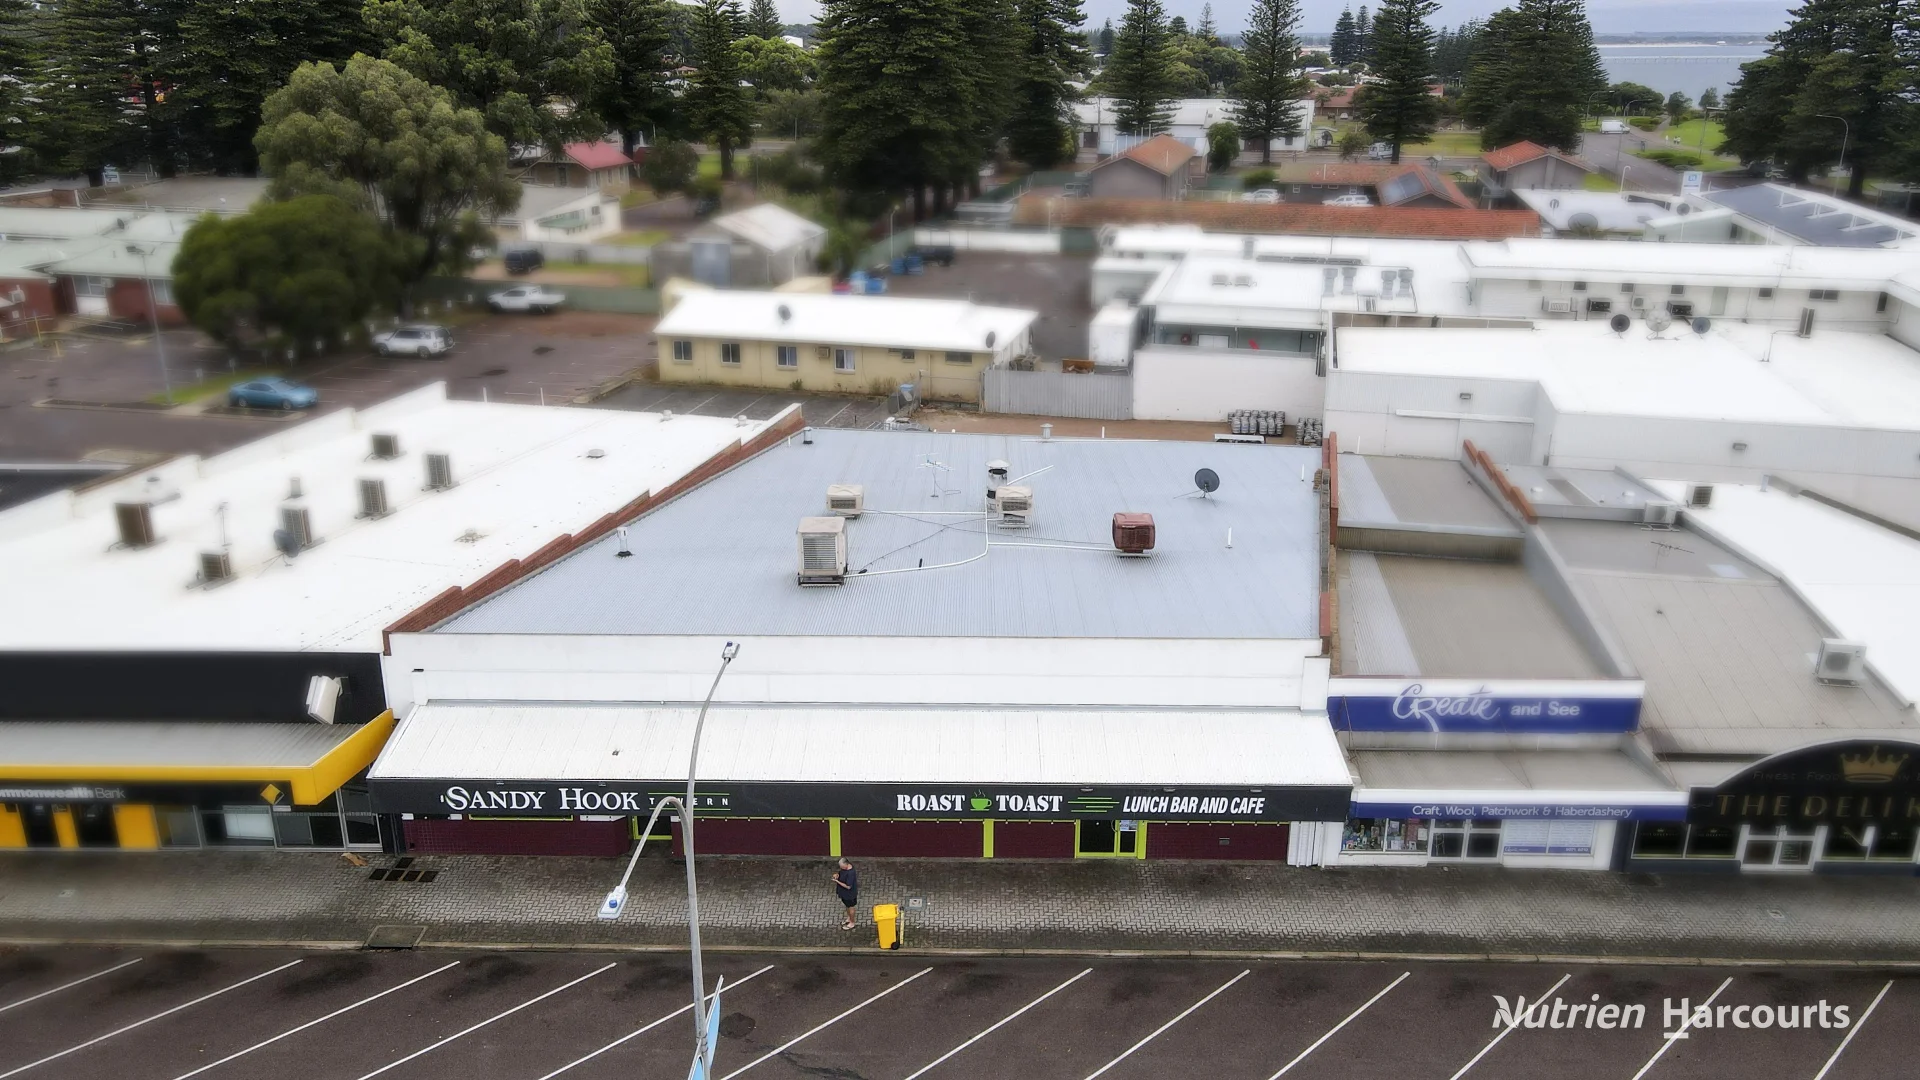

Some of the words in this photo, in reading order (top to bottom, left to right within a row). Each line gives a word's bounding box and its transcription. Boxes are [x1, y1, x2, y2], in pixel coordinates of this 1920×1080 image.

[1392, 683, 1500, 733] Create
[1510, 701, 1541, 716] and
[1548, 701, 1580, 716] See
[95, 787, 126, 799] Bank
[445, 786, 546, 811] SANDY
[558, 788, 640, 811] HOOK
[649, 797, 729, 806] TVERN
[896, 794, 966, 812] ROAST
[996, 795, 1063, 812] TOAST
[1122, 796, 1170, 814] LUNCH
[1170, 796, 1198, 814] BAR
[1198, 797, 1229, 814] AND
[1230, 797, 1266, 815] CAFE
[1412, 805, 1442, 817] Craft,
[1445, 805, 1477, 817] Wool,
[1481, 806, 1539, 816] Patchwork
[1543, 806, 1551, 816] &
[1555, 806, 1633, 819] Haberdashery
[1716, 795, 1791, 816] THE
[1803, 796, 1893, 818] DELI
